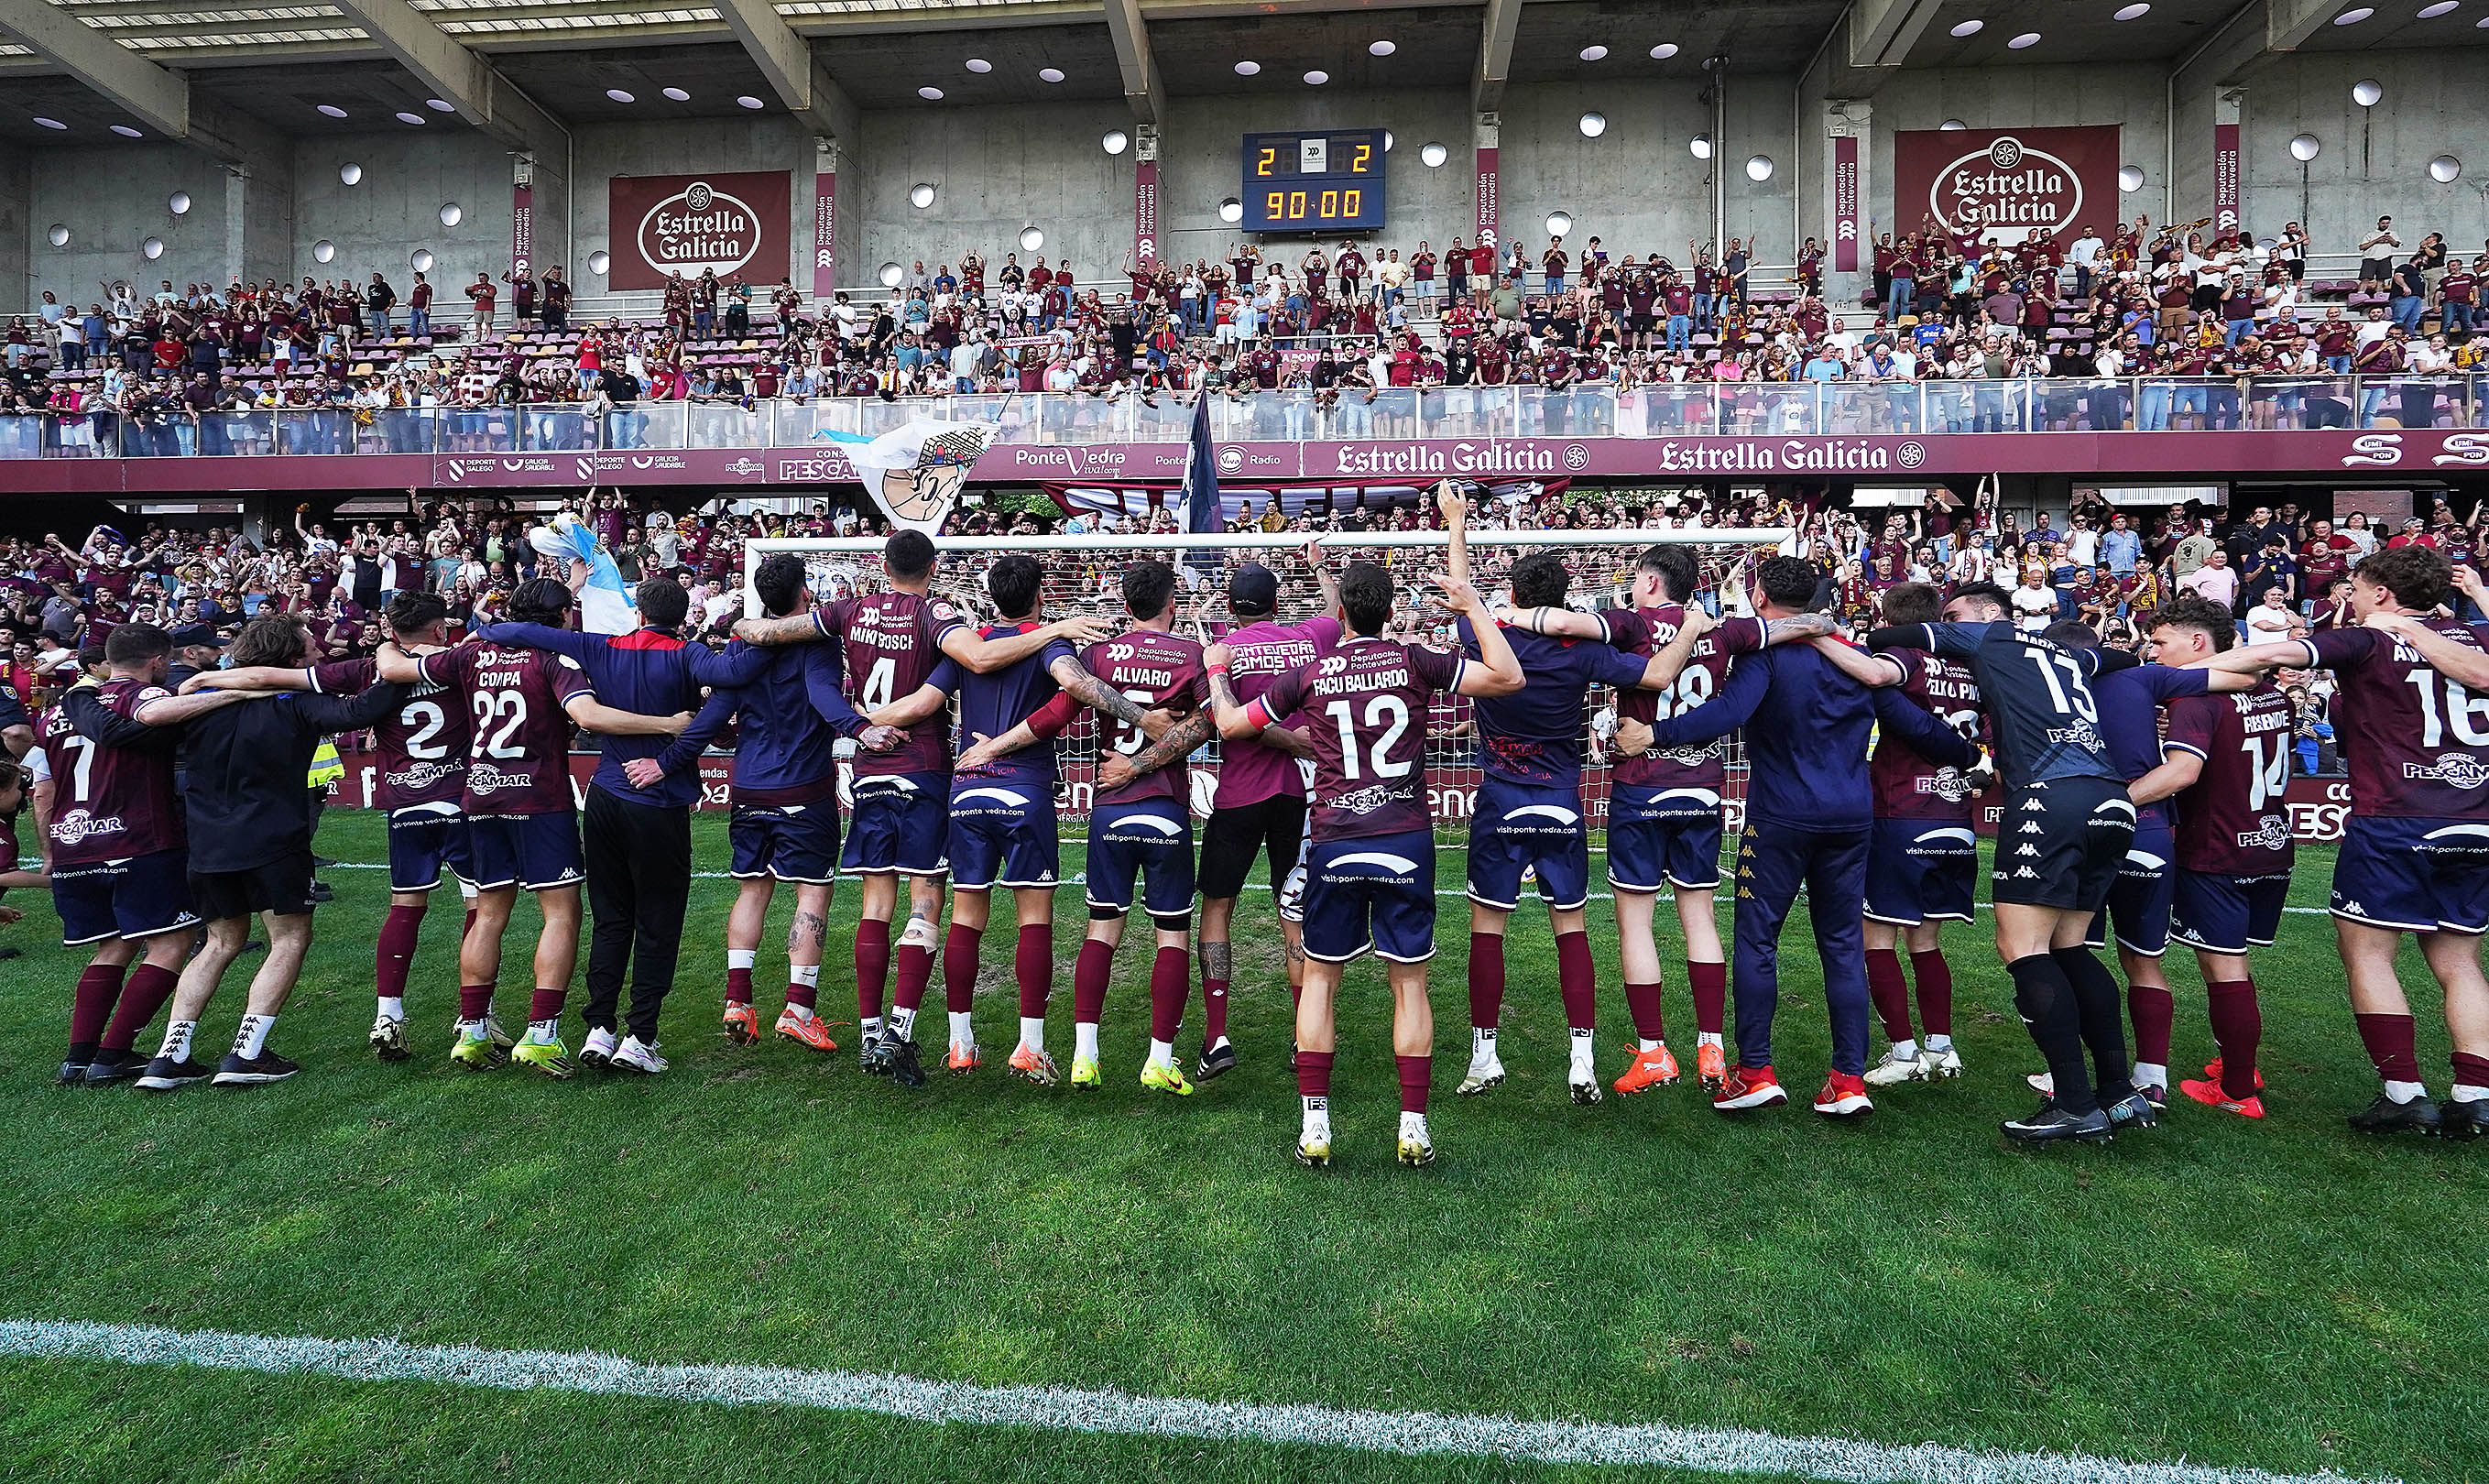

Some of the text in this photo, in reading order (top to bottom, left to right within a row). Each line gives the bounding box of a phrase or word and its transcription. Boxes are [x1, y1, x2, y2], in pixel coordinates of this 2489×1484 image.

[1258, 148, 1275, 176] 2
[1352, 145, 1370, 172] 2
[1838, 162, 1846, 216] Deputación
[1847, 162, 1855, 216] Pontevedra
[1951, 169, 2063, 198] Estrella
[2218, 150, 2227, 206] Deputación
[2227, 150, 2236, 205] Pontevedra
[1138, 184, 1147, 235] Deputación
[1147, 184, 1155, 235] Pontevedra
[1479, 173, 1488, 225] Deputación
[1488, 172, 1496, 225] Pontevedra
[1957, 195, 2057, 224] Galicia
[655, 211, 745, 235] Estrella
[817, 196, 825, 246] Deputación
[660, 235, 740, 260] Galicia
[1250, 455, 1281, 465] Radio
[1336, 442, 1555, 473] Estrella Galicia
[1659, 440, 1890, 471] Estrella Galicia
[1136, 653, 1184, 665] Pontevedra
[1137, 647, 1187, 659] Deputación
[1351, 651, 1402, 663] Deputación
[1351, 657, 1403, 670] Pontevedra
[863, 657, 896, 713] 4
[1111, 666, 1172, 687] ALVARO
[1313, 669, 1409, 697] FACU BALLARDO
[2024, 647, 2098, 724] 13
[470, 690, 527, 758] 22
[2243, 710, 2290, 733] RESENDE
[2404, 670, 2489, 747] 16
[400, 701, 449, 758] 2
[1325, 694, 1413, 780] 12
[62, 735, 95, 802] 7
[699, 768, 729, 779] endas
[2241, 732, 2290, 812] 14
[49, 815, 126, 838] ESCAMAR
